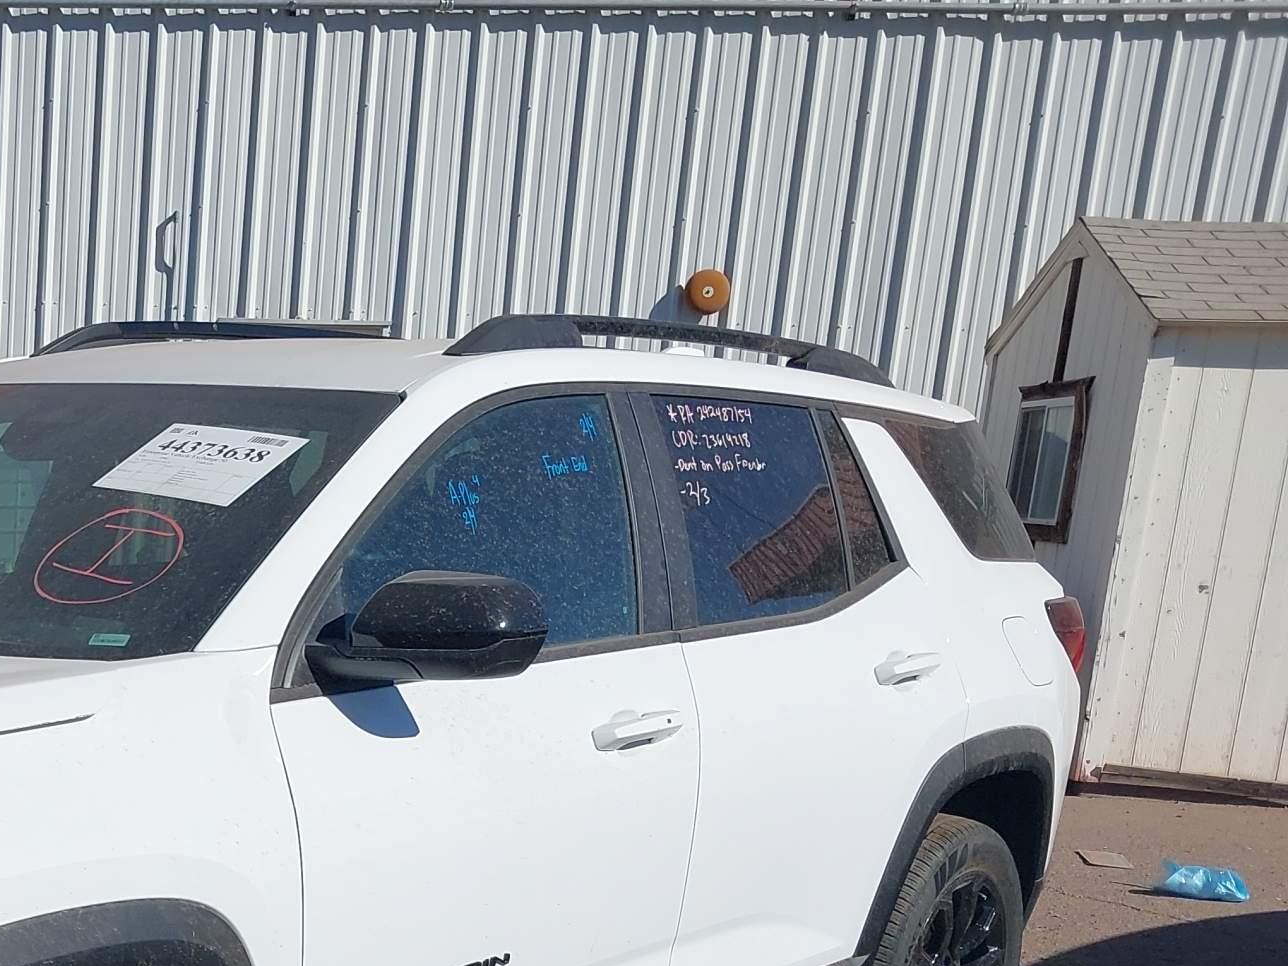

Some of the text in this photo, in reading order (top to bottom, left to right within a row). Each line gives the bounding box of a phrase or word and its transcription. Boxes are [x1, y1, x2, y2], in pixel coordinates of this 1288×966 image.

[158, 438, 272, 464] 44373638
[541, 453, 588, 480] Front End
